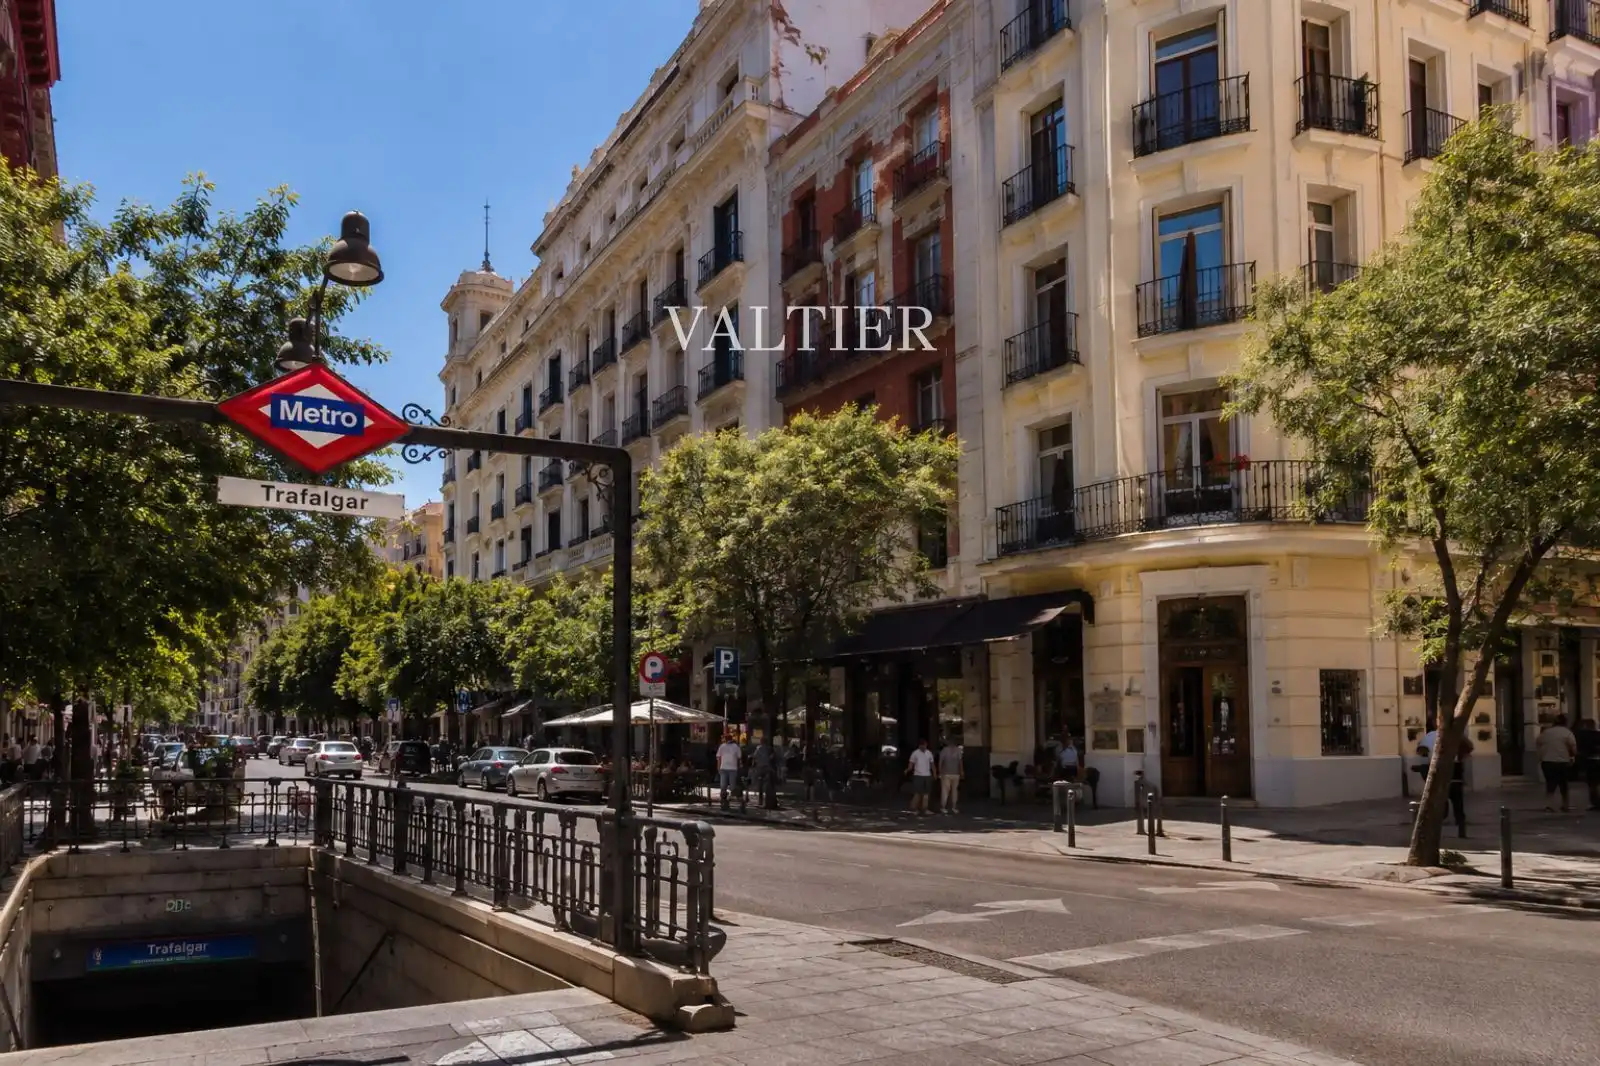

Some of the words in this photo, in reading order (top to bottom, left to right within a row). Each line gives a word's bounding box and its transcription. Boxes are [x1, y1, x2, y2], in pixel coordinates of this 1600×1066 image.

[279, 399, 358, 428] Metro
[261, 484, 369, 512] Trafalgar
[720, 649, 734, 675] P
[147, 941, 208, 956] Trafalgar
